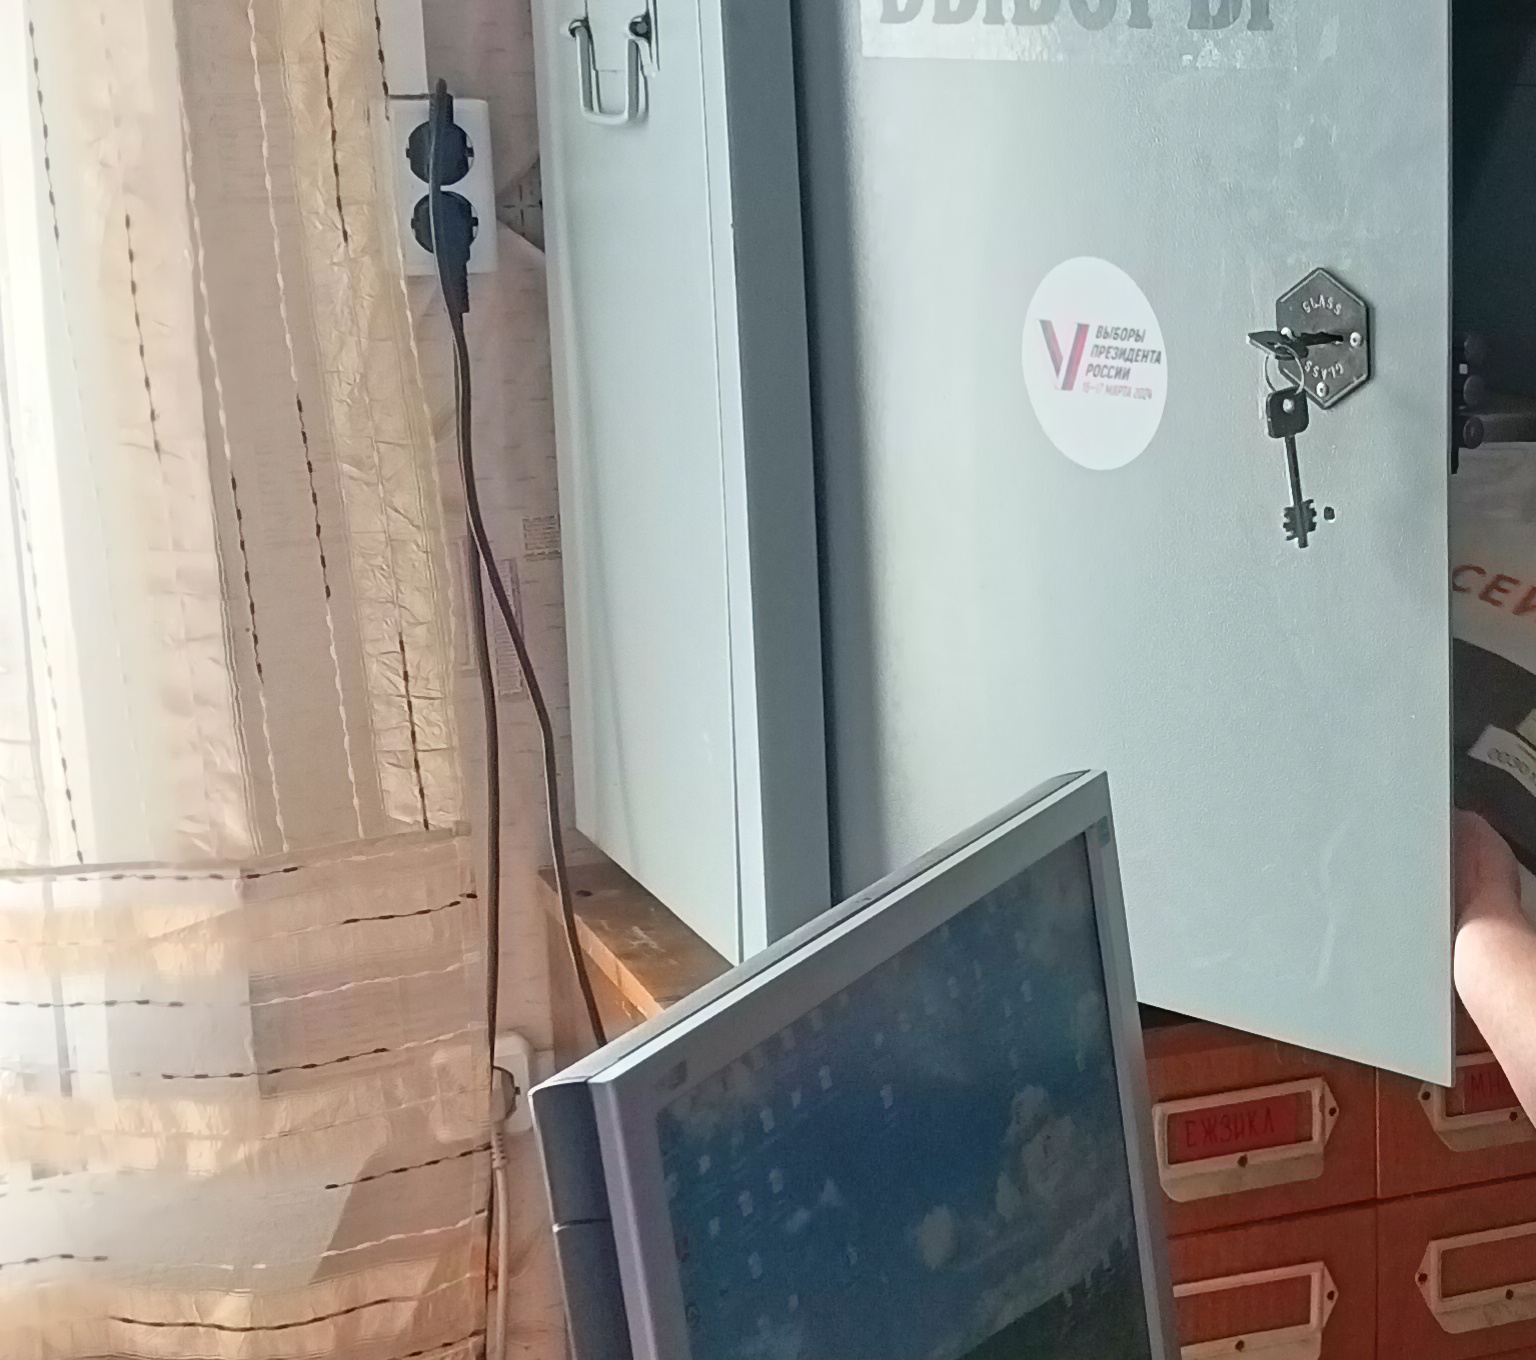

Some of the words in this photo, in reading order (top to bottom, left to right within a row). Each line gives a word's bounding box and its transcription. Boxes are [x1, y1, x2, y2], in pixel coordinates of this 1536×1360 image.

[1302, 295, 1342, 315] GLASS
[1096, 325, 1146, 343] ВЫБОРЫ
[1090, 344, 1162, 364] ПРЕЗИДЕНТА
[1085, 363, 1131, 381] РОССИИ
[1305, 361, 1343, 380] GLASS
